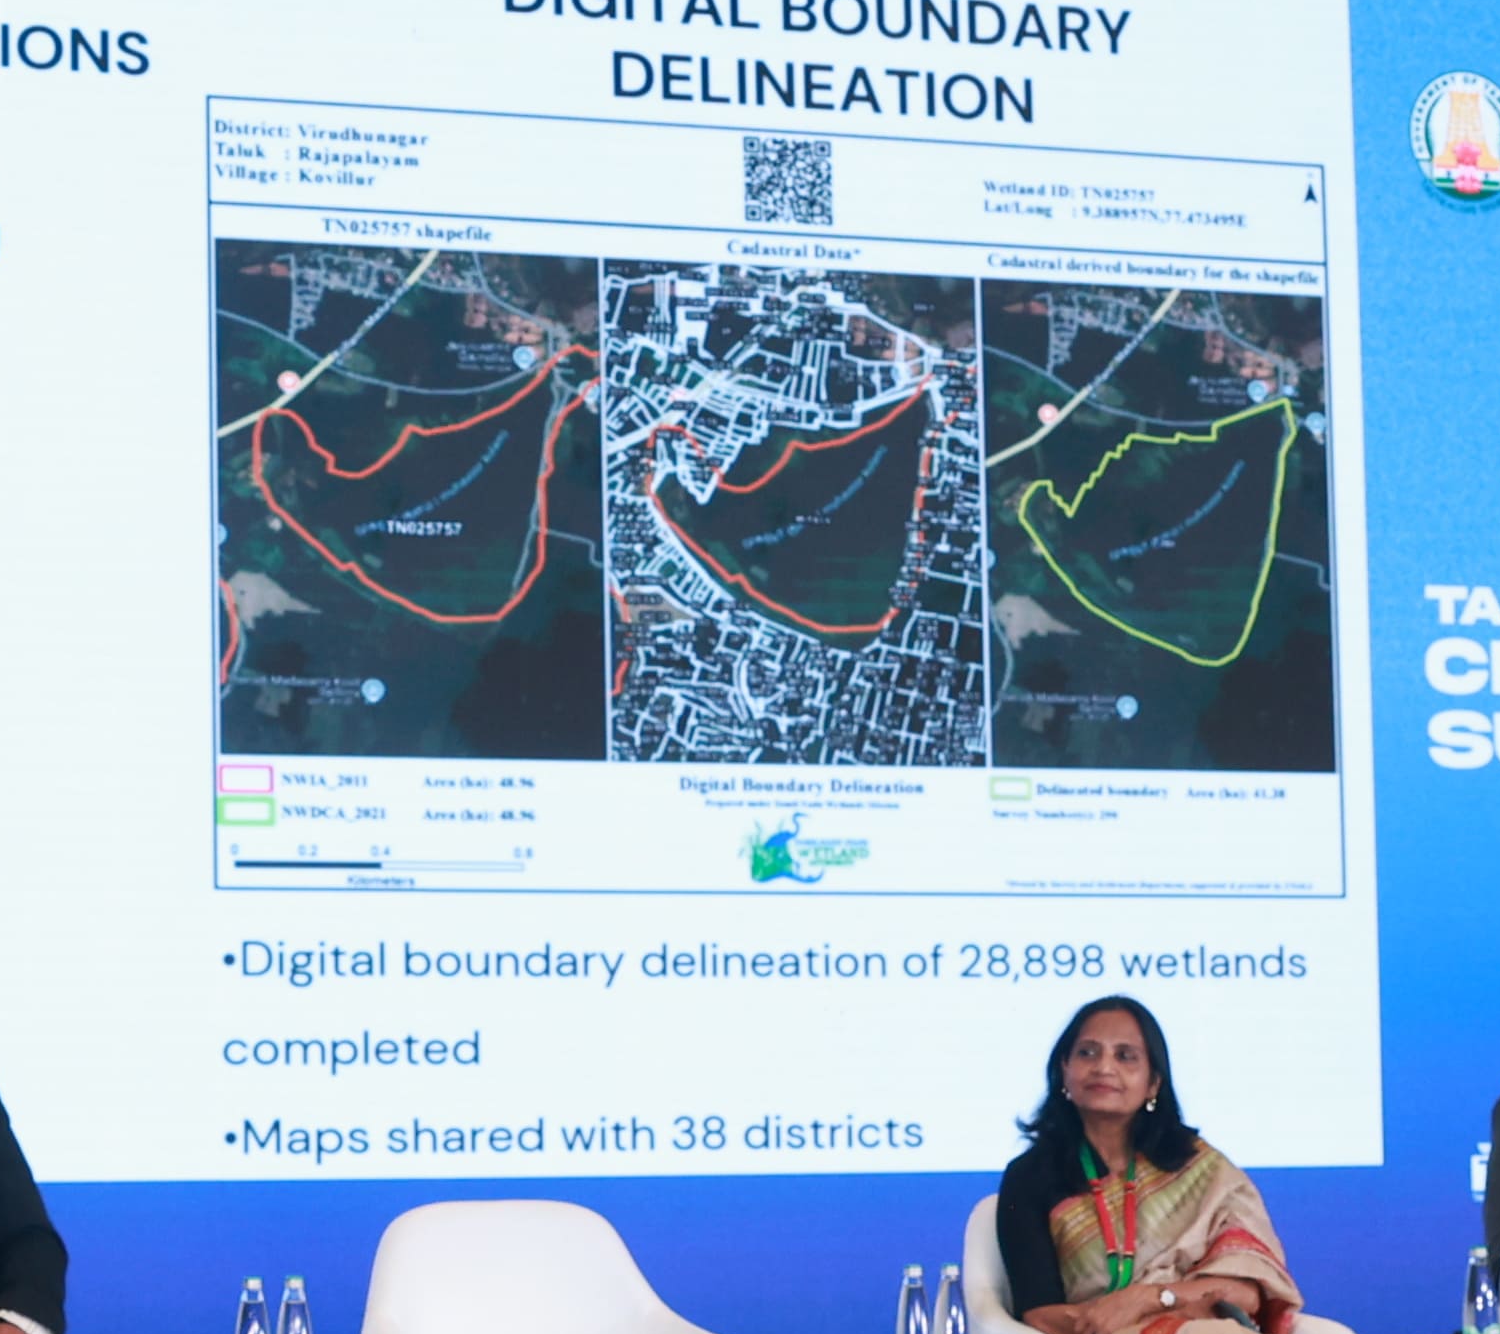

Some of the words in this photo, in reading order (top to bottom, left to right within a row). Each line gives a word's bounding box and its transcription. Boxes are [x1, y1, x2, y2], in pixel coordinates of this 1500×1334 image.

[611, 50, 1037, 124] DELINEATION
[299, 124, 427, 146] Virudhunagar
[216, 142, 264, 158] Taluk
[299, 147, 418, 168] Rajapalayam
[215, 165, 277, 183] Village
[299, 169, 375, 186] Kovillur
[322, 218, 413, 238] TN025757
[416, 224, 492, 244] shapefile
[727, 239, 807, 258] Cadastral
[987, 254, 1062, 272] Cadastral
[386, 518, 462, 538] TN025757
[680, 777, 735, 794] Digital
[742, 778, 822, 795] Boundary
[831, 779, 925, 794] Delineation
[405, 941, 623, 991] boundary
[641, 942, 886, 981] delineation
[902, 942, 944, 981] of
[959, 944, 1105, 986] 28,898
[1120, 944, 1307, 981] wetlands
[223, 1028, 481, 1075] completed
[386, 1115, 545, 1155] shared
[561, 1115, 656, 1153] with
[672, 1116, 727, 1151] 38
[742, 1113, 924, 1151] districts
